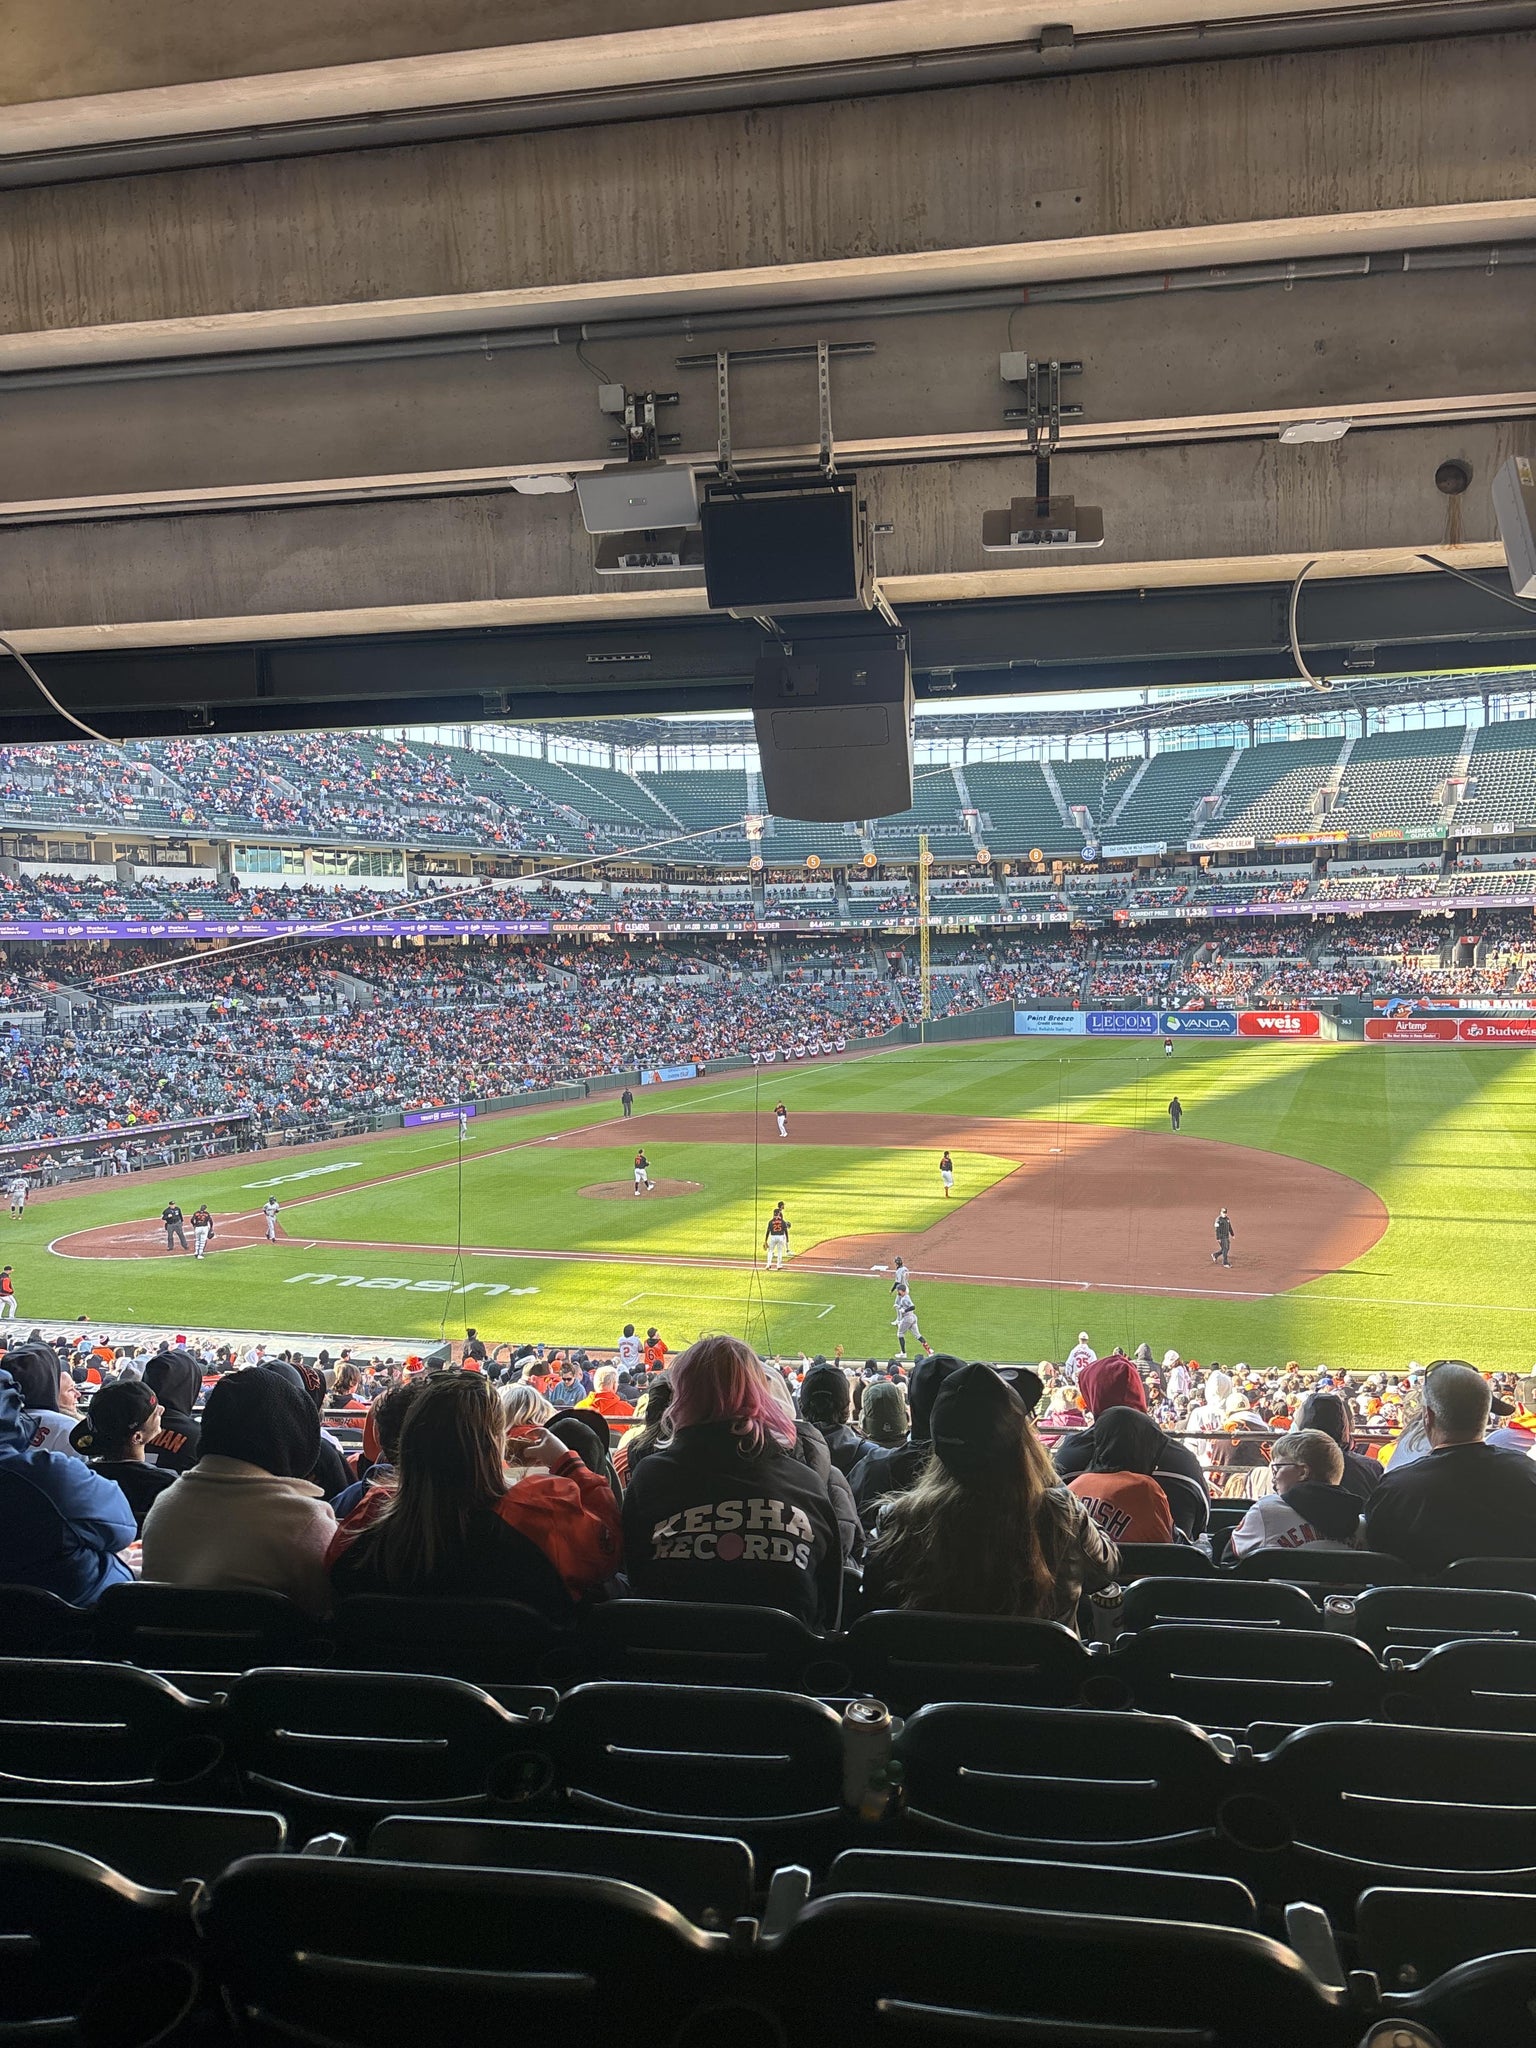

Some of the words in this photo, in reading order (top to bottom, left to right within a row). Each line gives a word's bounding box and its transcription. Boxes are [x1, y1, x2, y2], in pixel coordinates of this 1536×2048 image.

[1372, 829, 1402, 838] POMPEIAN
[1175, 908, 1208, 917] $11,336
[927, 916, 941, 924] MIN
[969, 915, 984, 923] BAL
[624, 923, 650, 931] CLEMENS
[1459, 1000, 1488, 1009] BIRD
[1491, 999, 1527, 1009] BATH
[1092, 1016, 1151, 1027] LECOM
[1181, 1019, 1230, 1028] VANDA
[1256, 1015, 1301, 1029] weis
[1396, 1021, 1427, 1031] Airtemp
[283, 1272, 541, 1296] masn+
[623, 1346, 630, 1358] 2
[648, 1348, 655, 1361] 6
[1076, 1357, 1090, 1369] 35
[652, 1499, 815, 1543] KESHA
